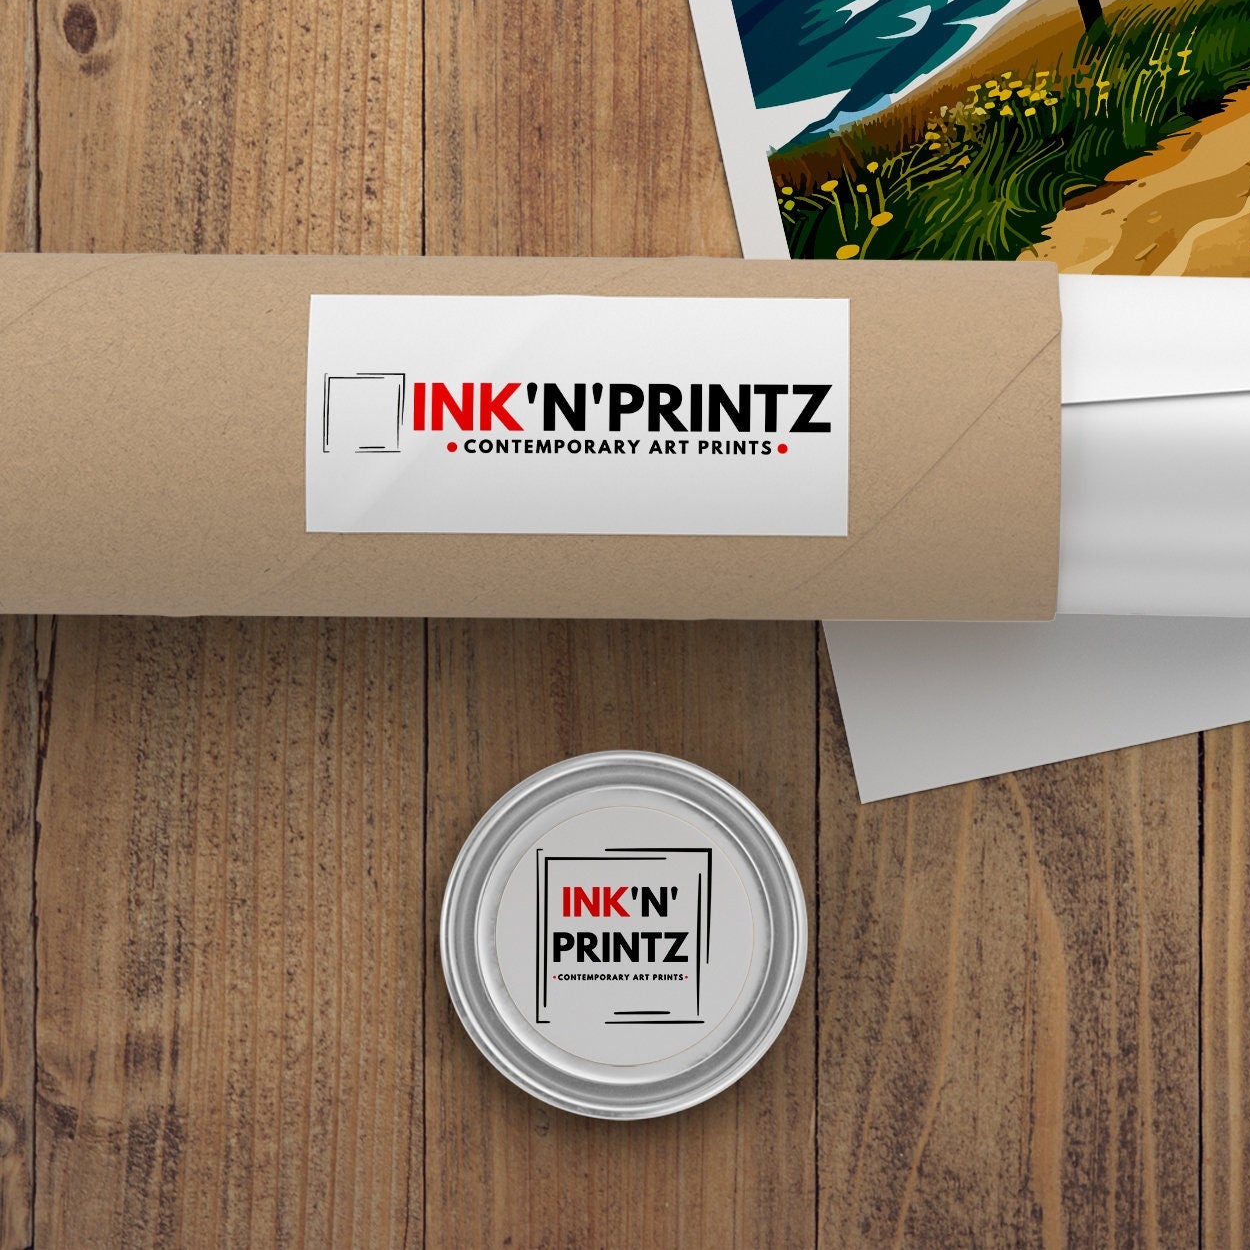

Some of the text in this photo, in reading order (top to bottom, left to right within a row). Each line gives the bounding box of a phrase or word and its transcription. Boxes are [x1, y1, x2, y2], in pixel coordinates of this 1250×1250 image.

[463, 438, 772, 456] CONTEMPORARY ART PRINTS
[562, 885, 679, 918] INK'N'
[552, 931, 690, 963] PRINTZ
[557, 973, 684, 981] CONTEMPORARY ART PRINTS
